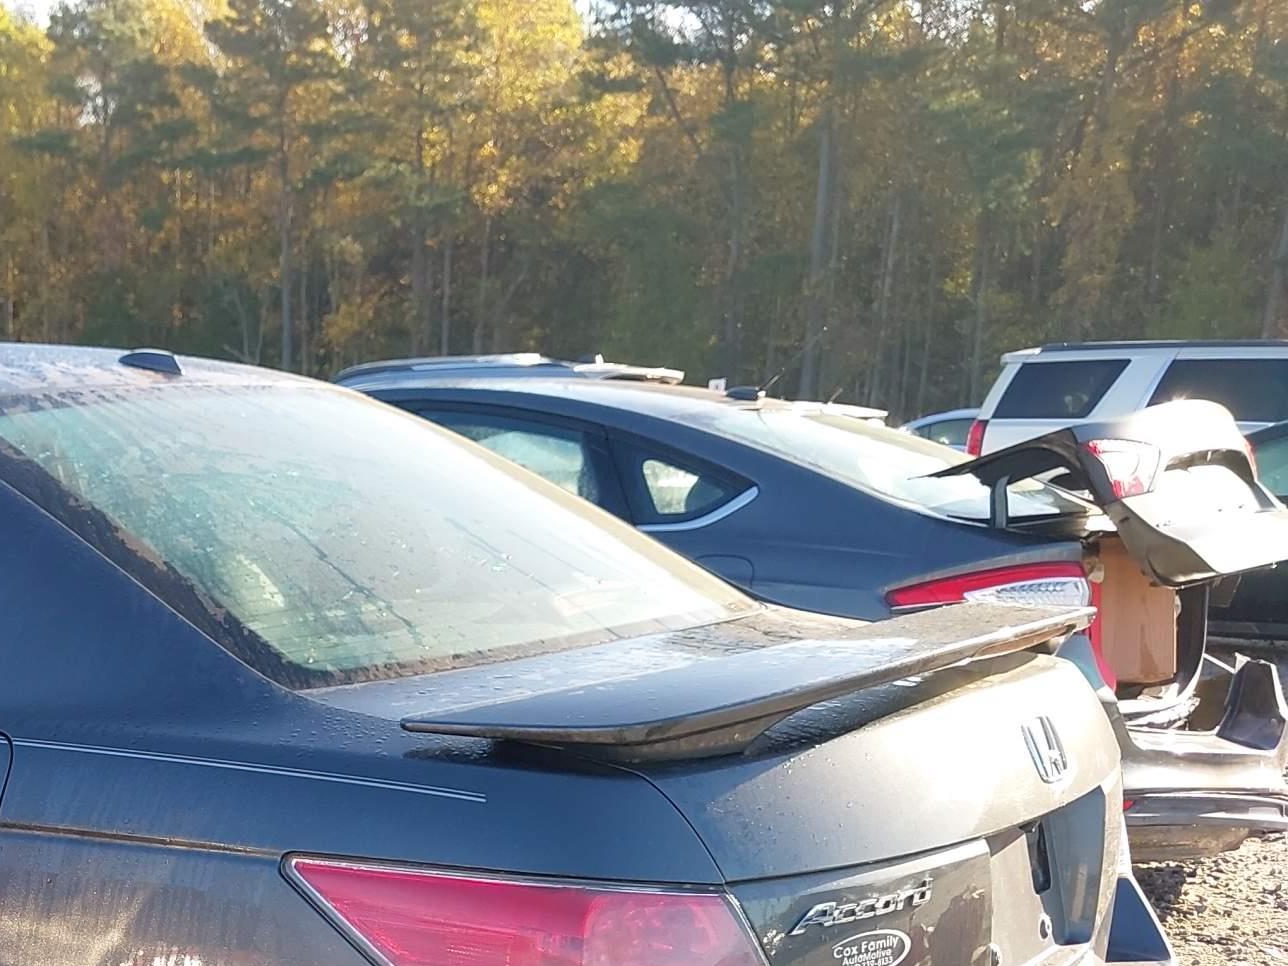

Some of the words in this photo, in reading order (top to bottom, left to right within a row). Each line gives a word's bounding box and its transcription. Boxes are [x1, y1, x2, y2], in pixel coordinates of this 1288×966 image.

[788, 876, 933, 936] Accord
[833, 946, 858, 958] Cox
[861, 935, 899, 953] Family
